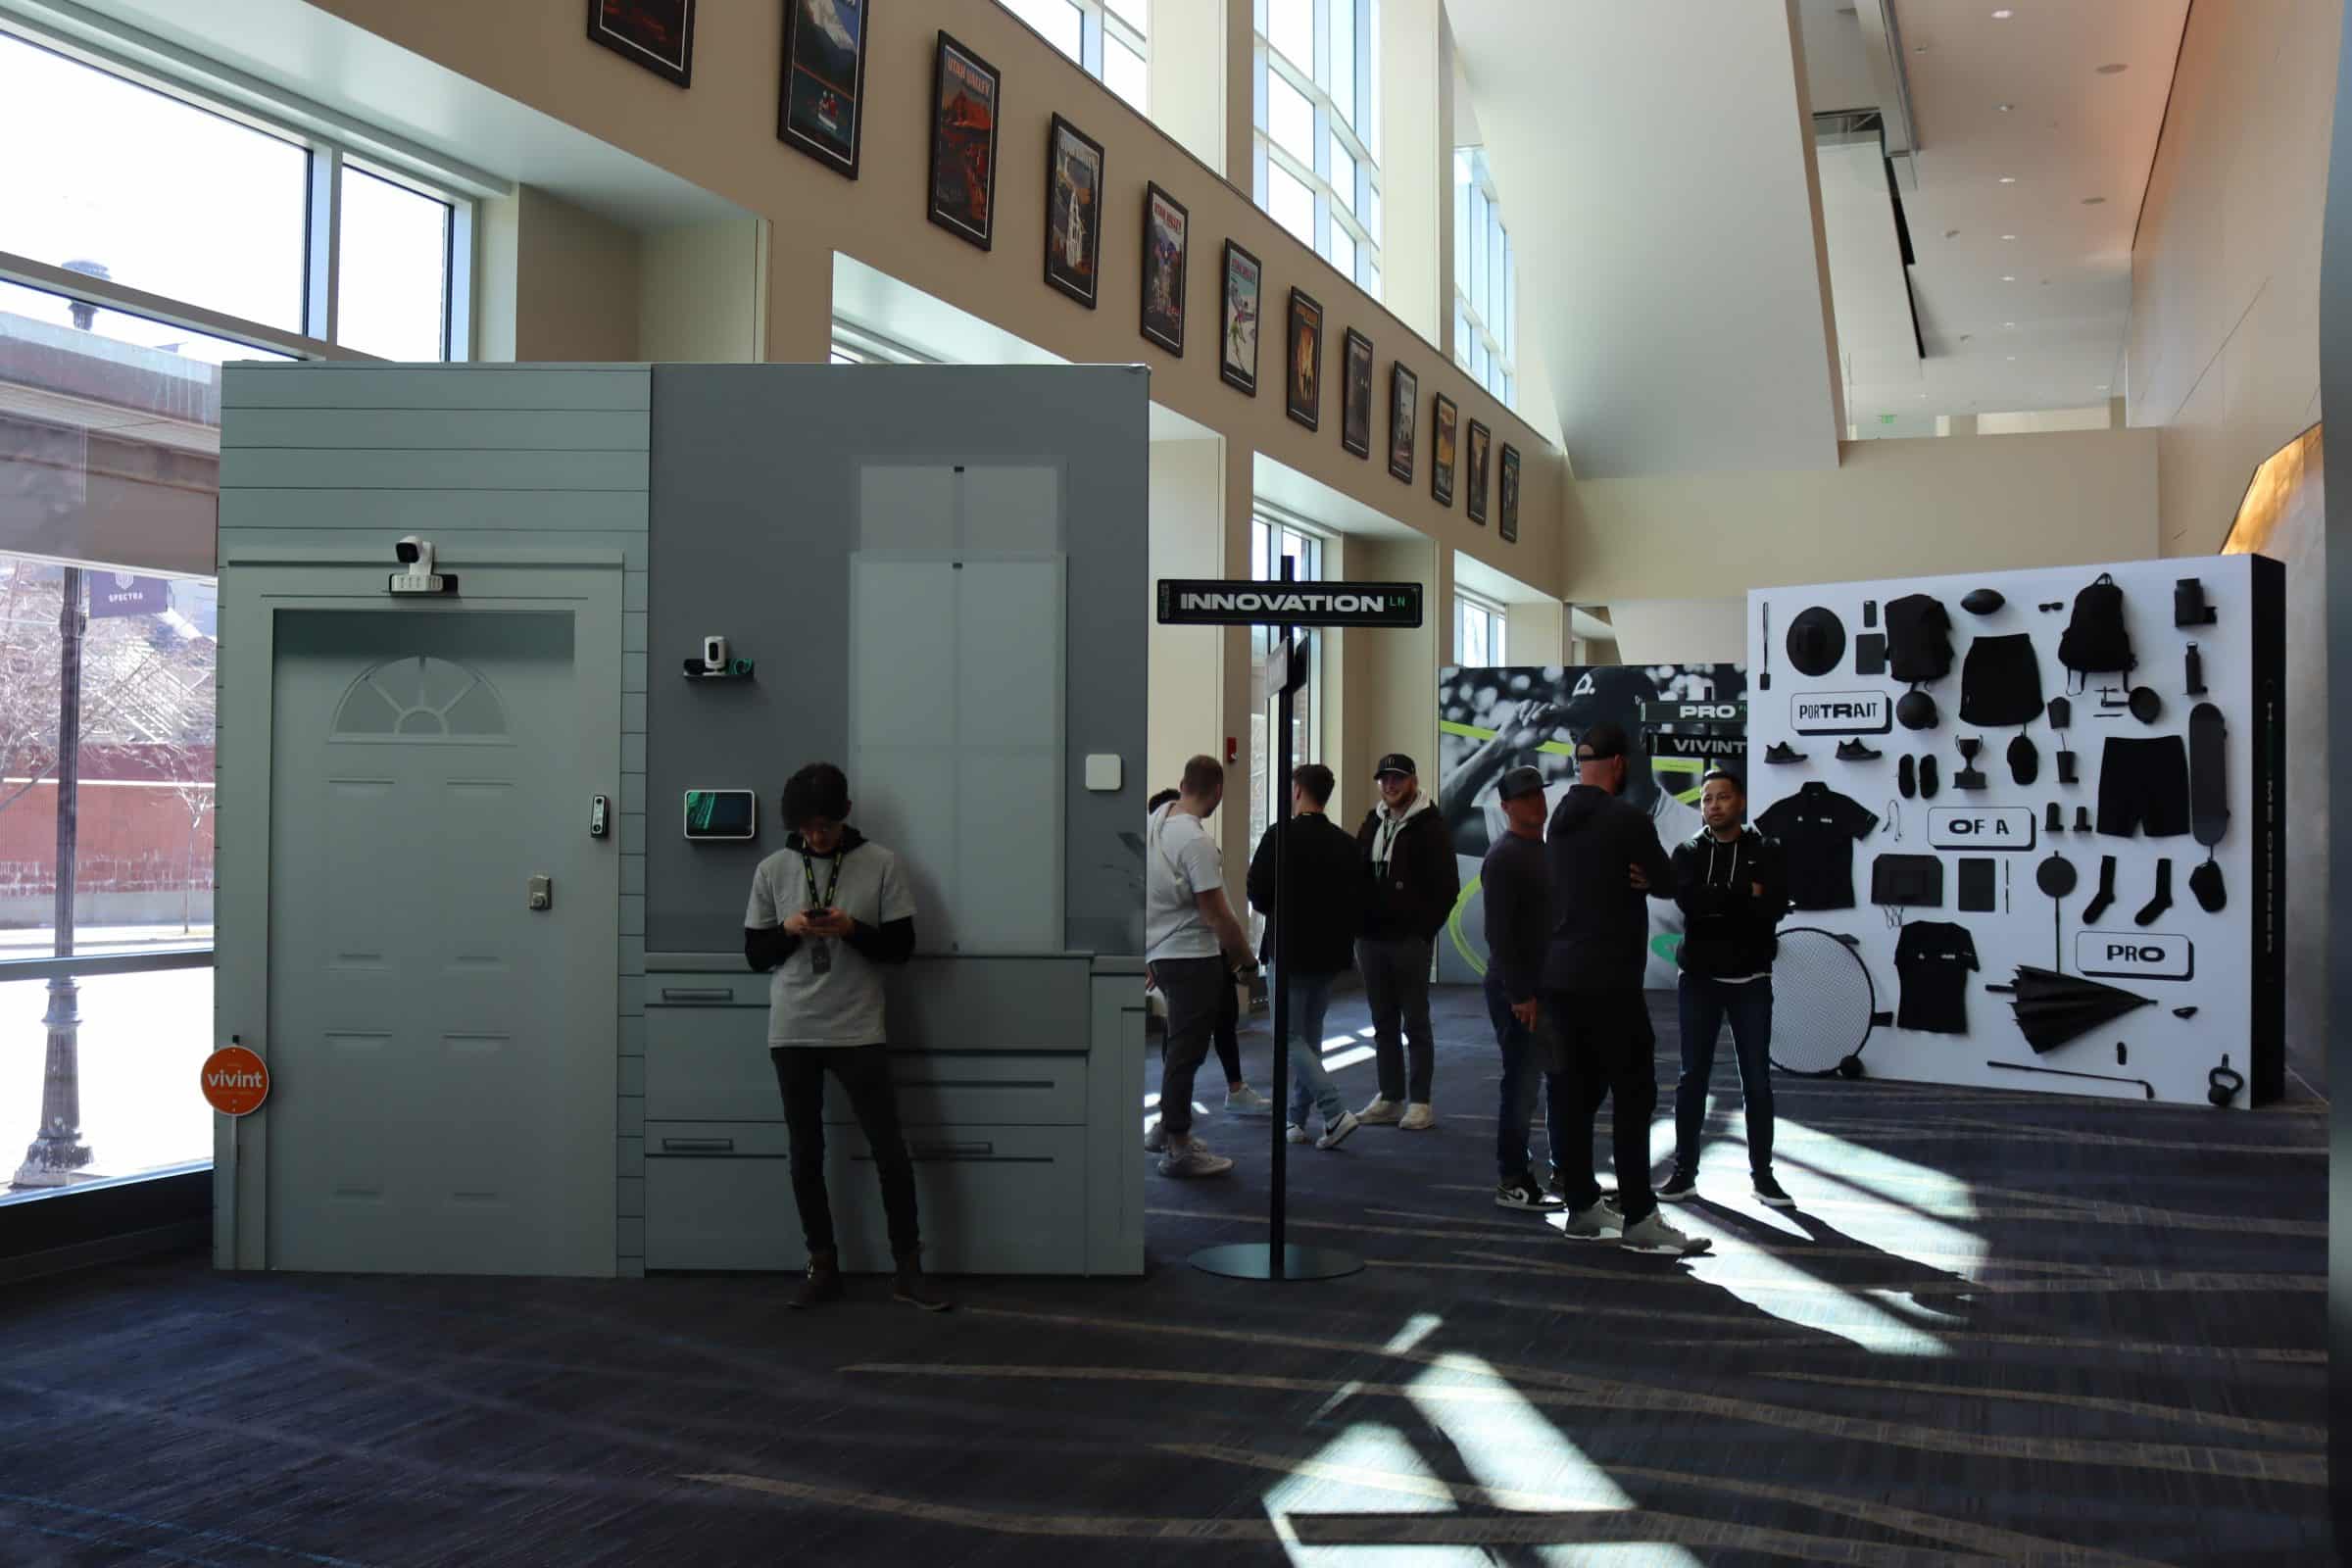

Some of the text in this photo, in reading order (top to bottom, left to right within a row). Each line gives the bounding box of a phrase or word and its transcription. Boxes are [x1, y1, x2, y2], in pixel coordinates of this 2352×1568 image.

[1181, 593, 1385, 612] INNOVATION
[1389, 596, 1406, 608] LN
[1679, 705, 1737, 719] PRO
[1799, 702, 1878, 719] PORTRAIT
[1674, 738, 1746, 754] VIVINT
[1948, 818, 2009, 835] OF A
[2106, 944, 2166, 962] PRO
[207, 1069, 263, 1089] vivint
